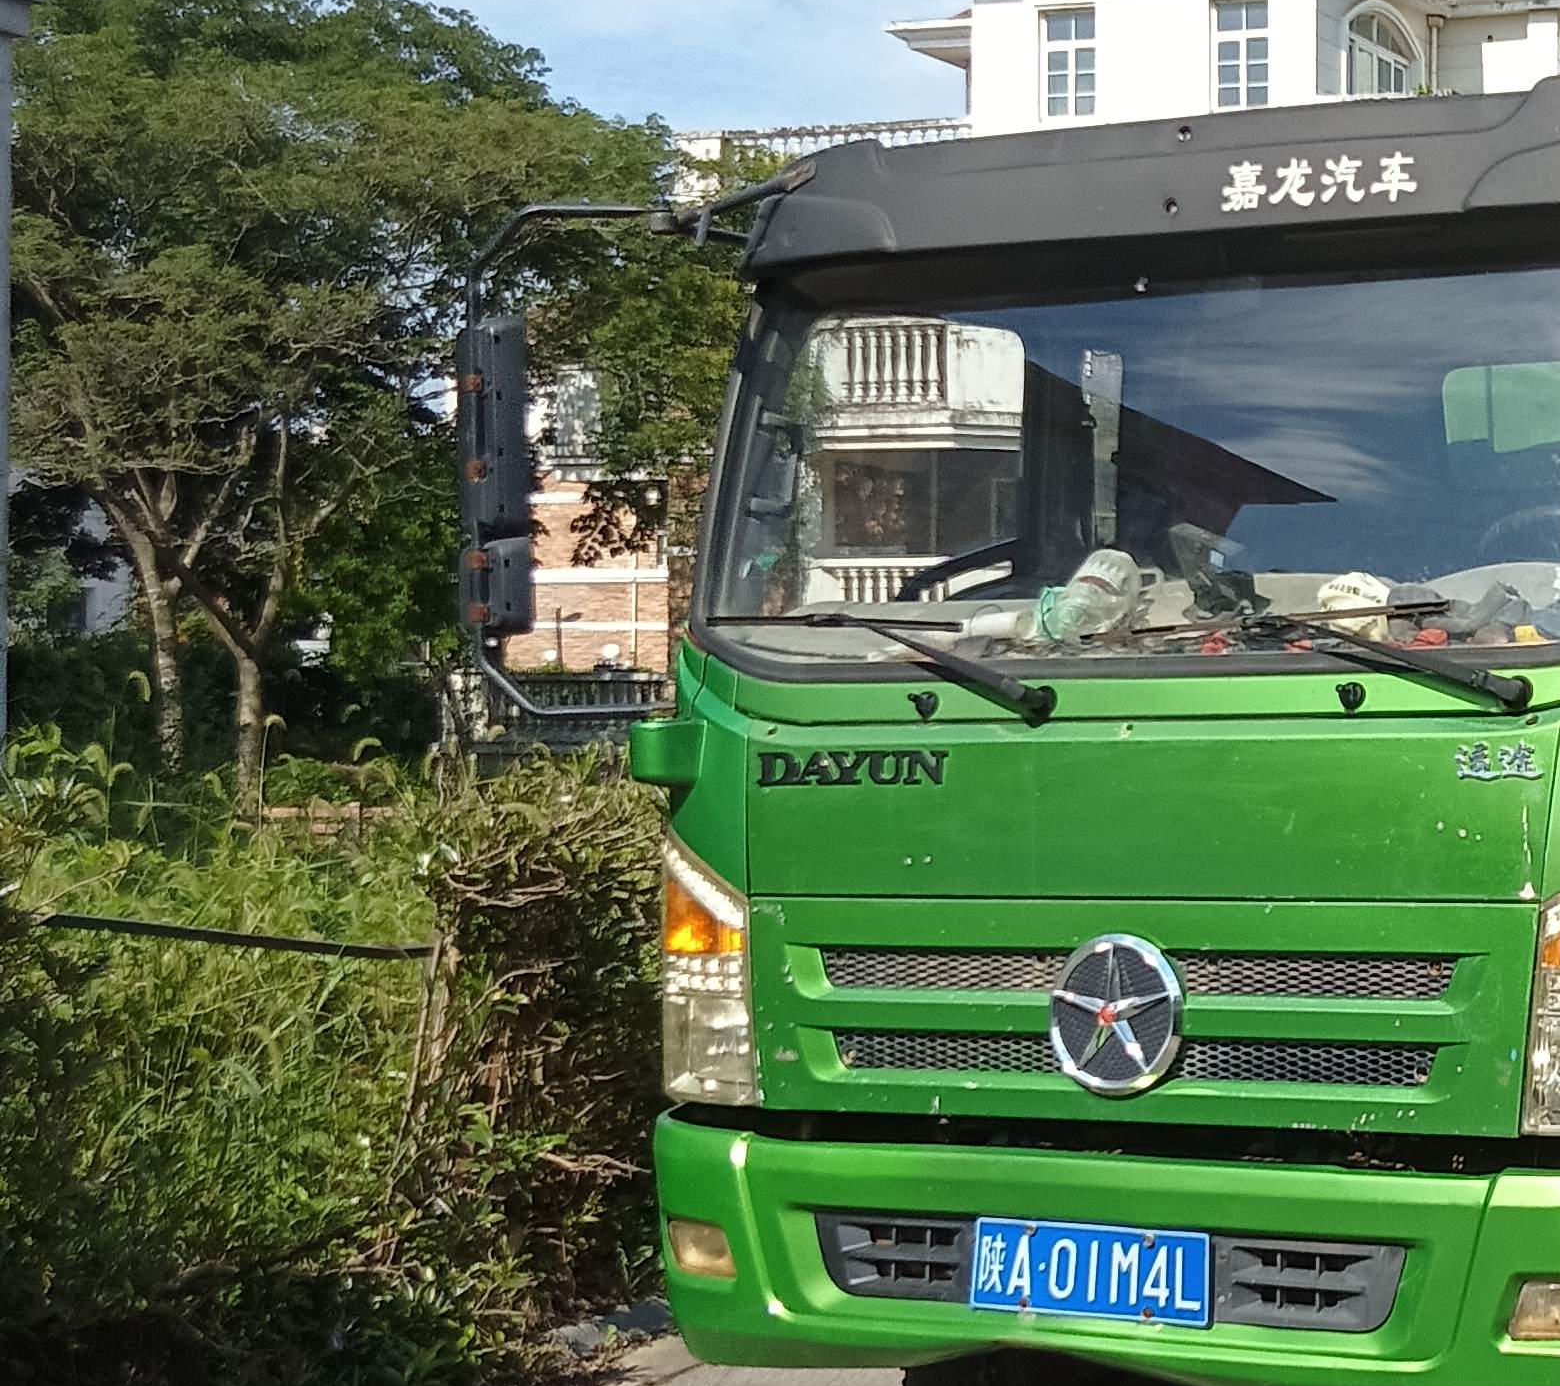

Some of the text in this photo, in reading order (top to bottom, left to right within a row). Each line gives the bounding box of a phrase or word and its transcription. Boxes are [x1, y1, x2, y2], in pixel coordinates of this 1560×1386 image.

[1221, 151, 1417, 212] 嘉龙汽车
[756, 750, 949, 787] DAYUN
